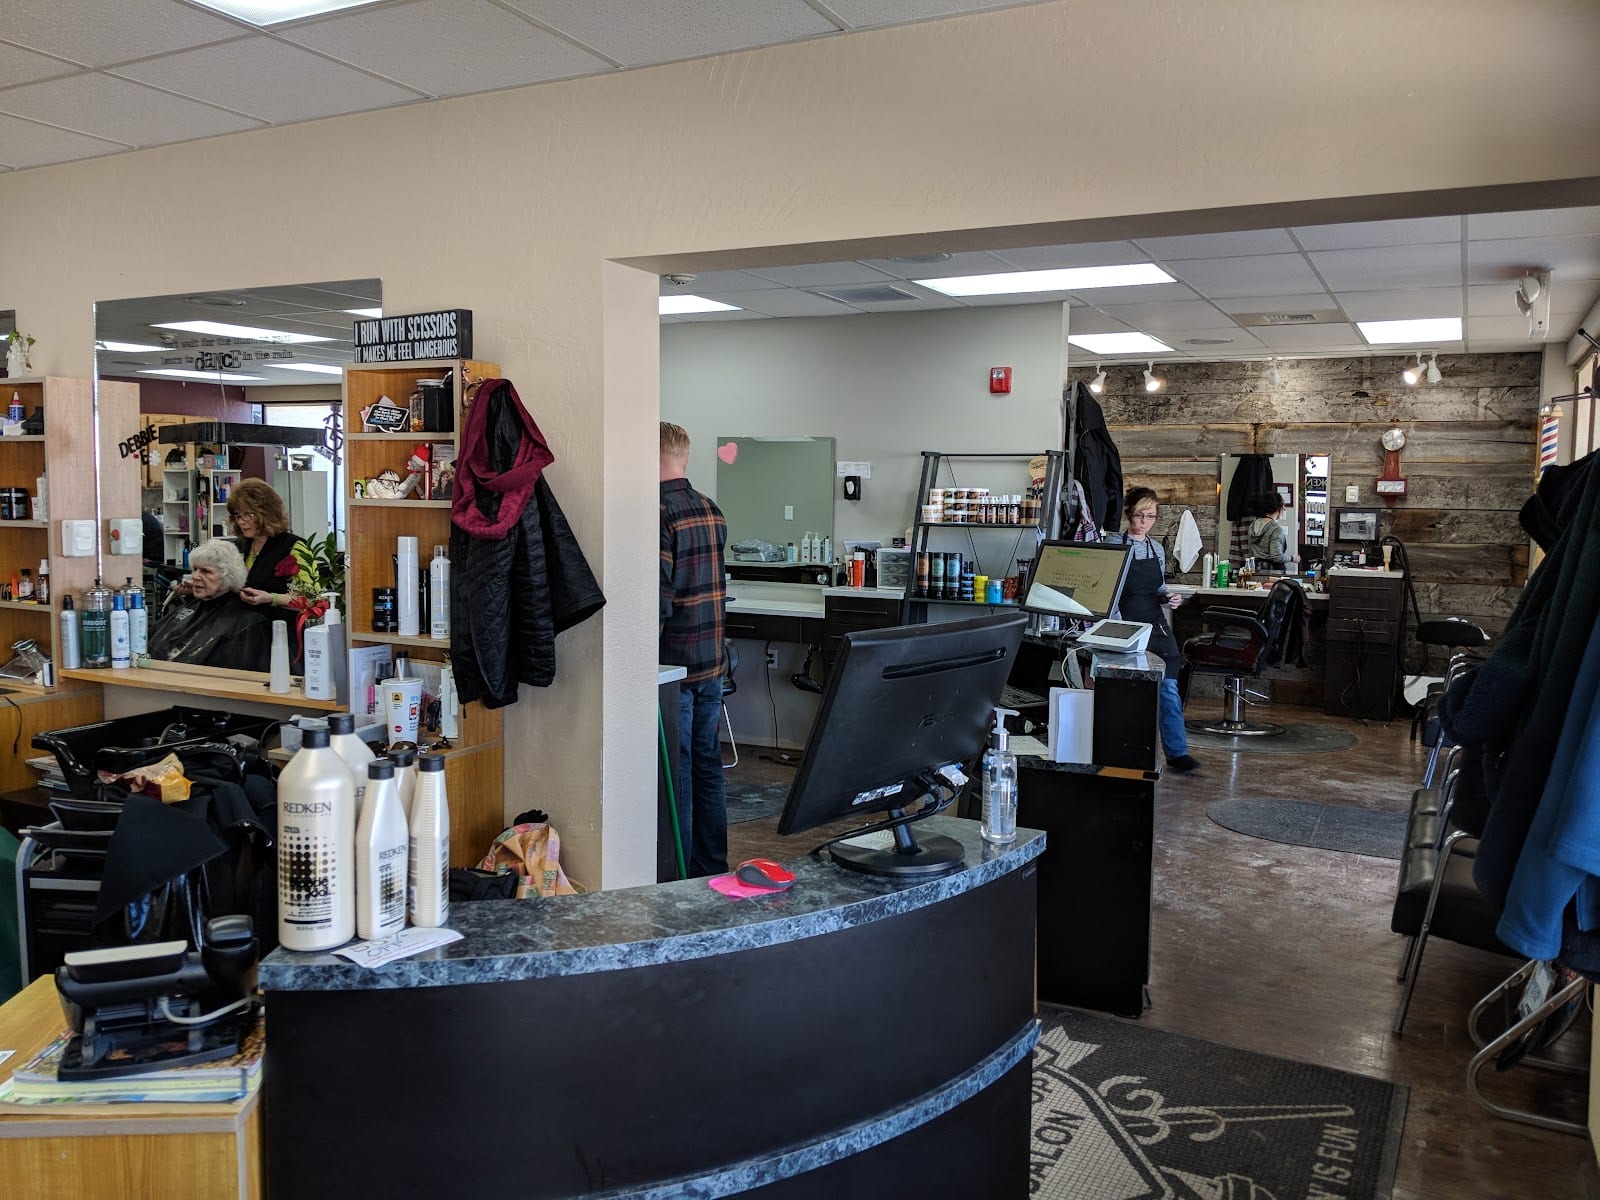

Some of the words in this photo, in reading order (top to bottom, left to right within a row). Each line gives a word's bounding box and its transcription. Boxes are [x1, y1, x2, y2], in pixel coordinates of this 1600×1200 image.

[354, 323, 359, 345] I
[360, 321, 380, 344] RUN
[381, 318, 406, 342] WITH
[407, 312, 457, 340] SCISSORS
[242, 352, 253, 360] in
[255, 351, 270, 360] the
[354, 346, 362, 363] IT
[363, 344, 386, 362] MAKES
[386, 342, 397, 360] ME
[397, 341, 413, 359] FEEL
[414, 338, 458, 358] DANGEROUS
[118, 424, 159, 459] DEBBIE
[283, 801, 332, 814] REDKEN
[1316, 1122, 1359, 1163] FUN
[1311, 1162, 1352, 1186] IS
